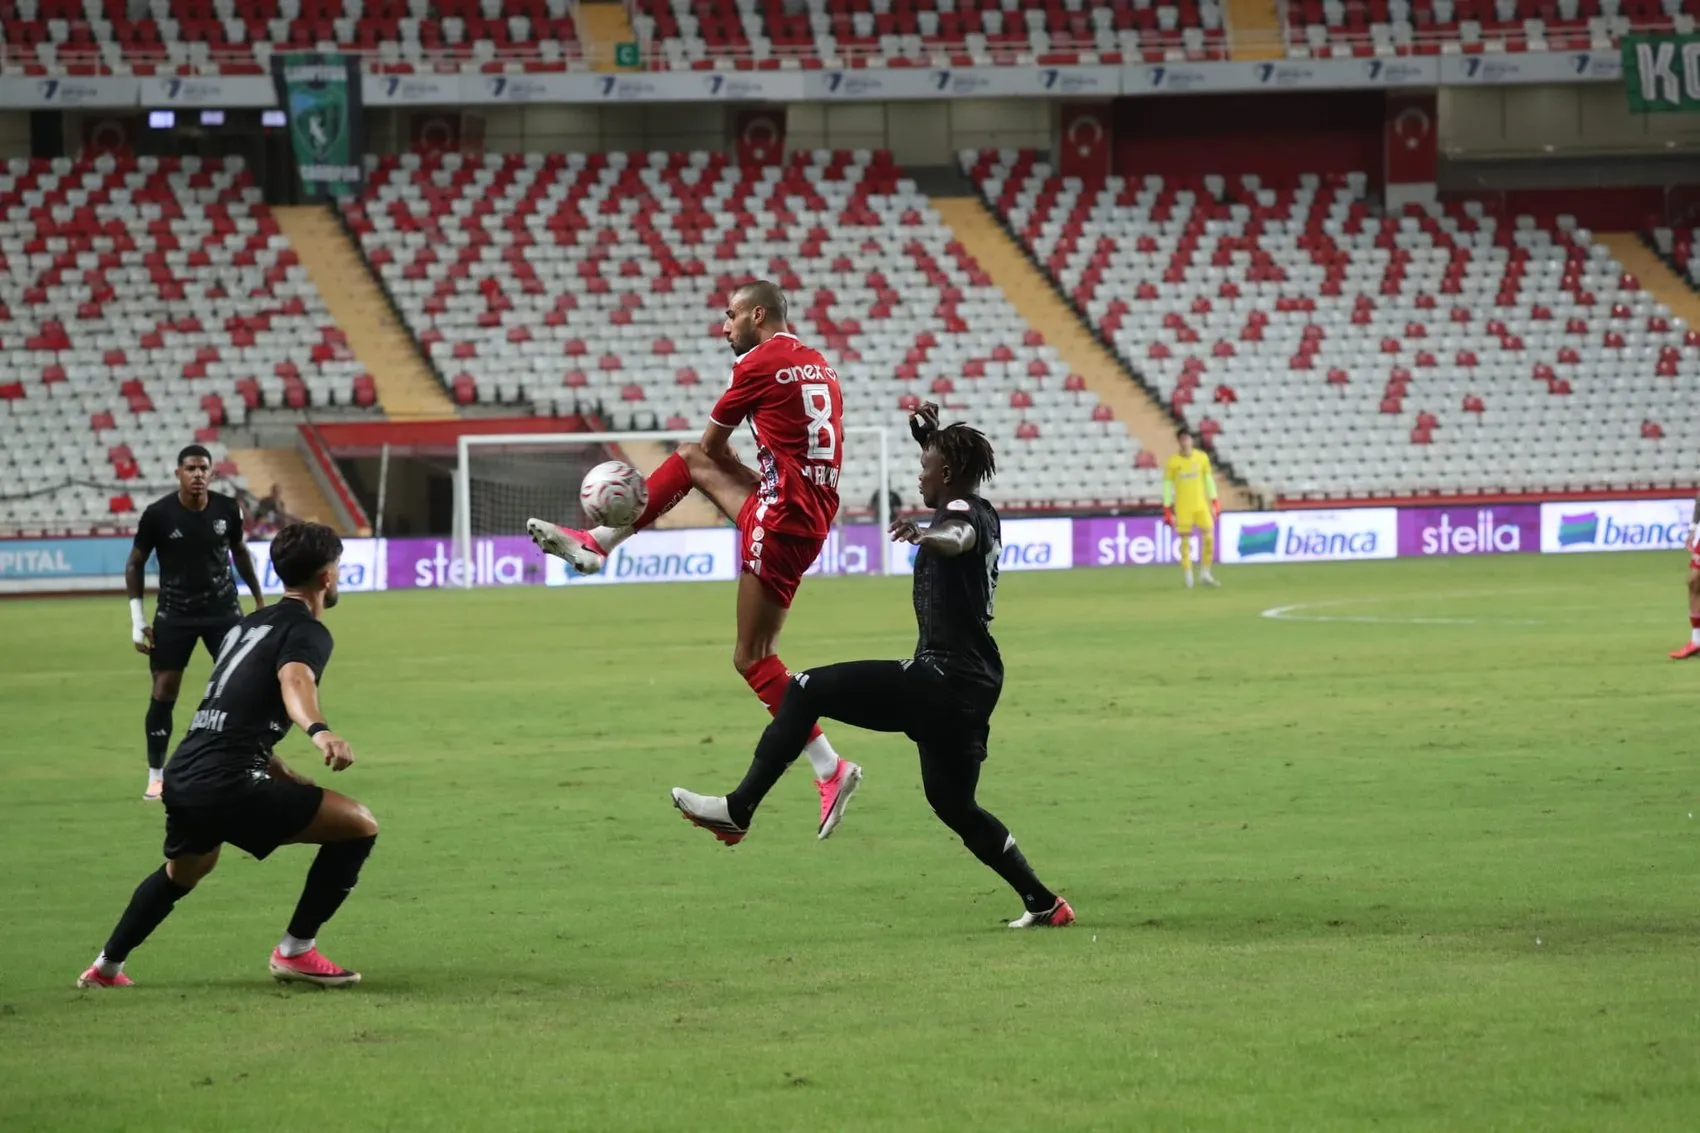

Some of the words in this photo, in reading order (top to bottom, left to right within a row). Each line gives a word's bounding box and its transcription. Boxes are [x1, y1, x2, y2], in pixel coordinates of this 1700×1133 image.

[801, 384, 835, 460] 8
[1098, 521, 1199, 566] stella
[1285, 526, 1377, 555] bianca
[1422, 509, 1521, 554] stella
[414, 540, 524, 587] stella
[615, 547, 714, 578] bianca
